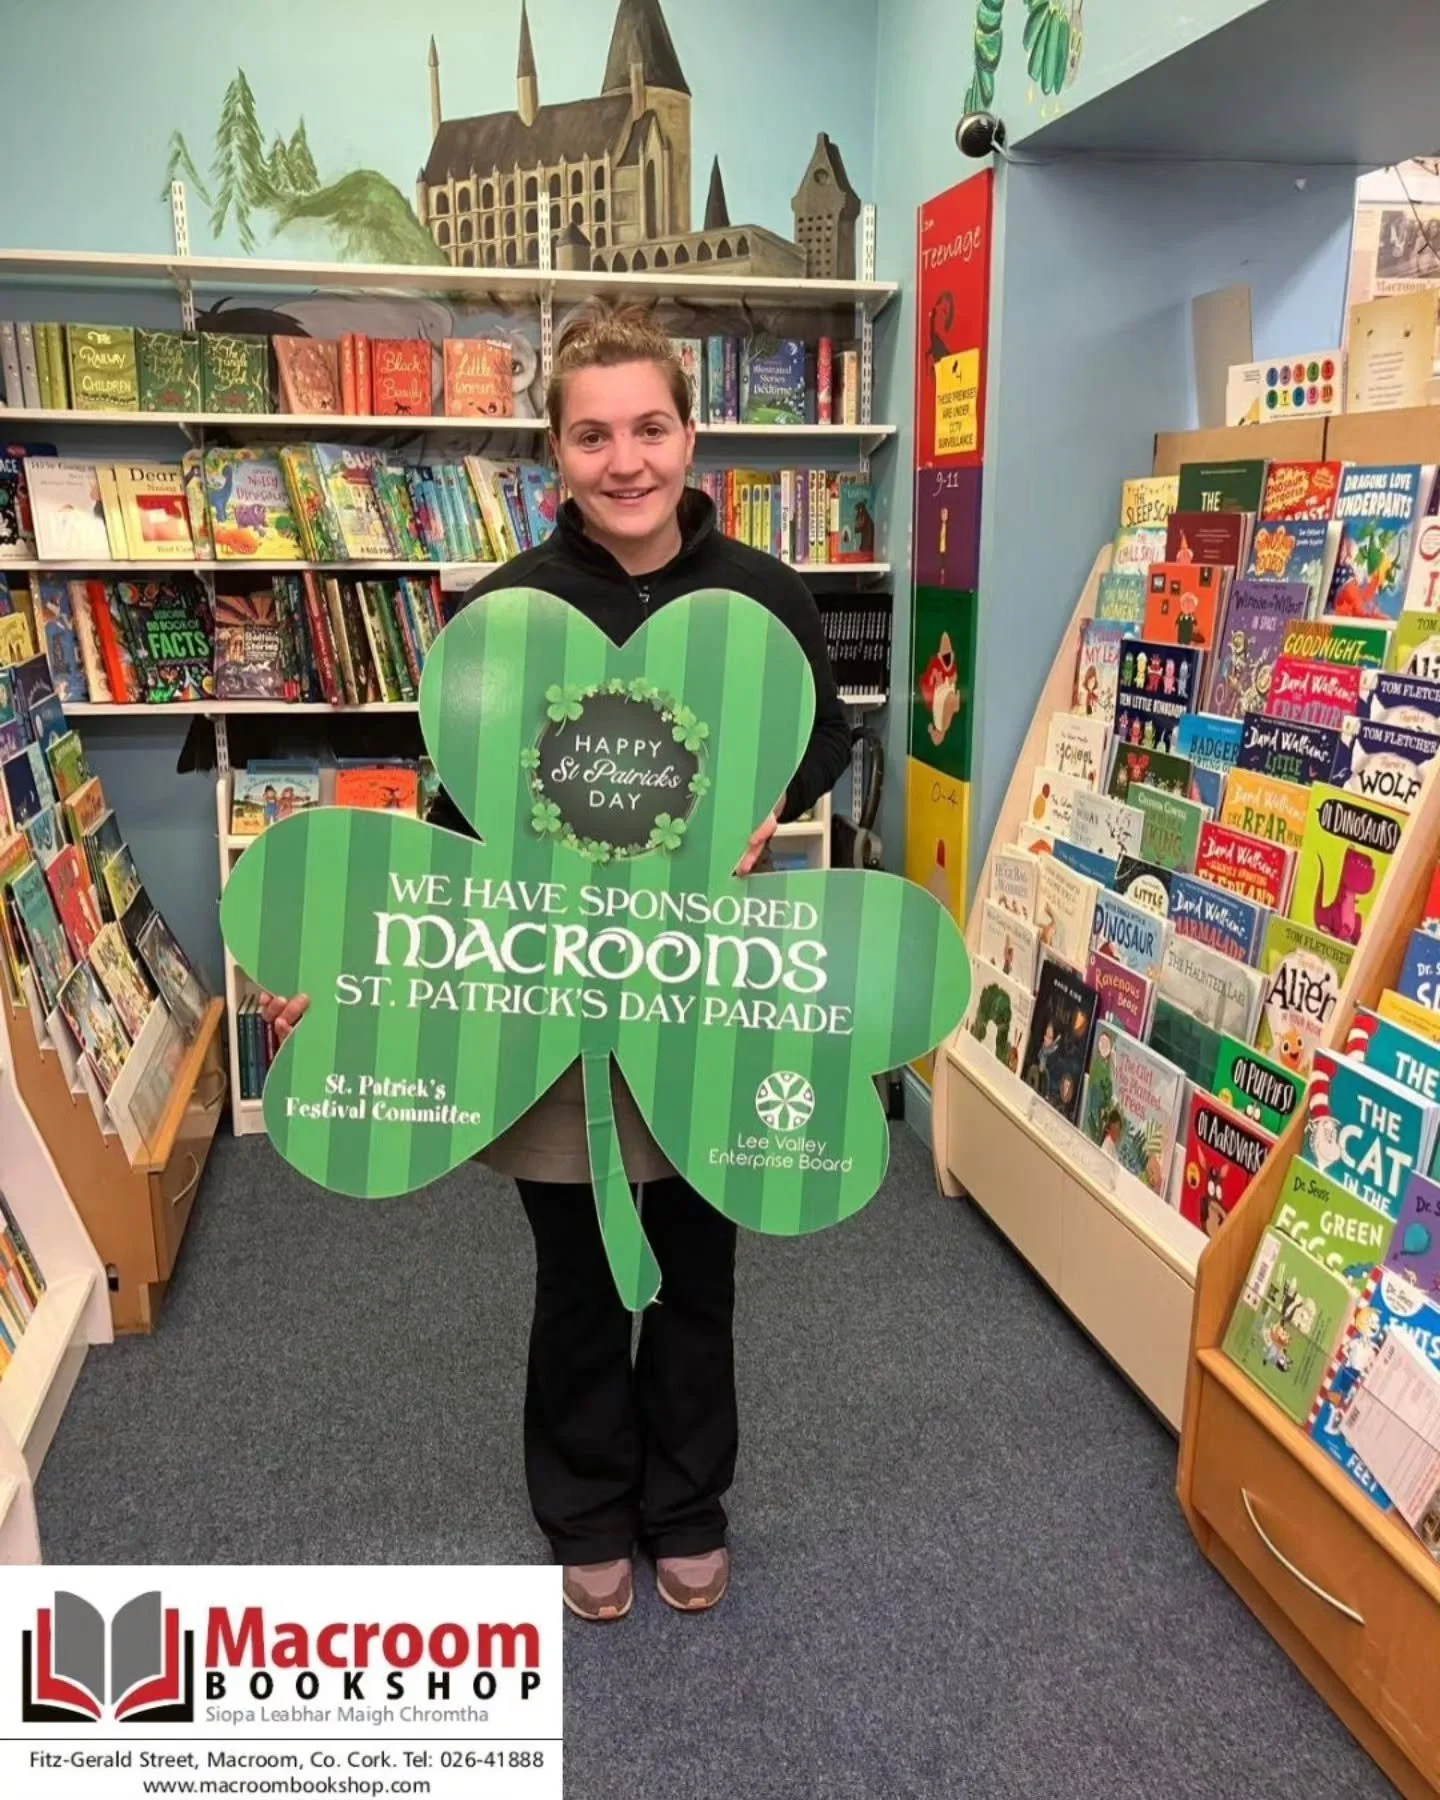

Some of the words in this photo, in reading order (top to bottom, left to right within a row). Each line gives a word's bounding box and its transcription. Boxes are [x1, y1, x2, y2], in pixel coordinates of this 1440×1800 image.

[922, 225, 981, 271] Teenage
[130, 467, 177, 482] Dear
[1344, 473, 1386, 495] DRAGONS
[1389, 472, 1412, 491] LOVE
[1201, 491, 1222, 512] THE
[1336, 491, 1413, 519] UNDERPANTS
[147, 630, 209, 659] FACTS
[1284, 632, 1367, 663] GOODNIGHT
[1381, 680, 1402, 695] TOM
[575, 735, 662, 758] HAPPY
[1244, 726, 1277, 750] David
[1363, 726, 1383, 742] TOM
[1384, 731, 1437, 755] FLETCHER
[551, 756, 580, 783] St
[583, 758, 681, 789] Patricks
[1358, 769, 1422, 804] WOLF
[589, 790, 641, 811] DAY
[1333, 803, 1398, 850] DINOSAURS!
[1203, 837, 1234, 858] David
[388, 871, 453, 906] WE
[462, 877, 569, 914] HAVE
[579, 884, 818, 931] SPONSORED
[1134, 886, 1163, 909] LITTLE
[1172, 890, 1203, 918] David
[1092, 903, 1154, 958] DINOSAUR
[373, 910, 828, 993] MACROOMS
[334, 974, 396, 1007] ST.
[407, 979, 608, 1020] PATRICK'S
[618, 991, 696, 1025] DAY
[703, 997, 854, 1036] PARADE
[325, 1073, 352, 1094] St.
[359, 1074, 446, 1100] Patrick's
[1395, 1051, 1439, 1100] THE
[285, 1097, 365, 1120] Festival
[372, 1101, 481, 1125] Committee
[1357, 1095, 1403, 1143] THE
[737, 1133, 769, 1150] Lee
[775, 1135, 828, 1155] Valley
[709, 1149, 794, 1171] Enterprise
[800, 1155, 853, 1173] Board
[1338, 1124, 1413, 1197] CAT
[1319, 1210, 1384, 1248] GREEN
